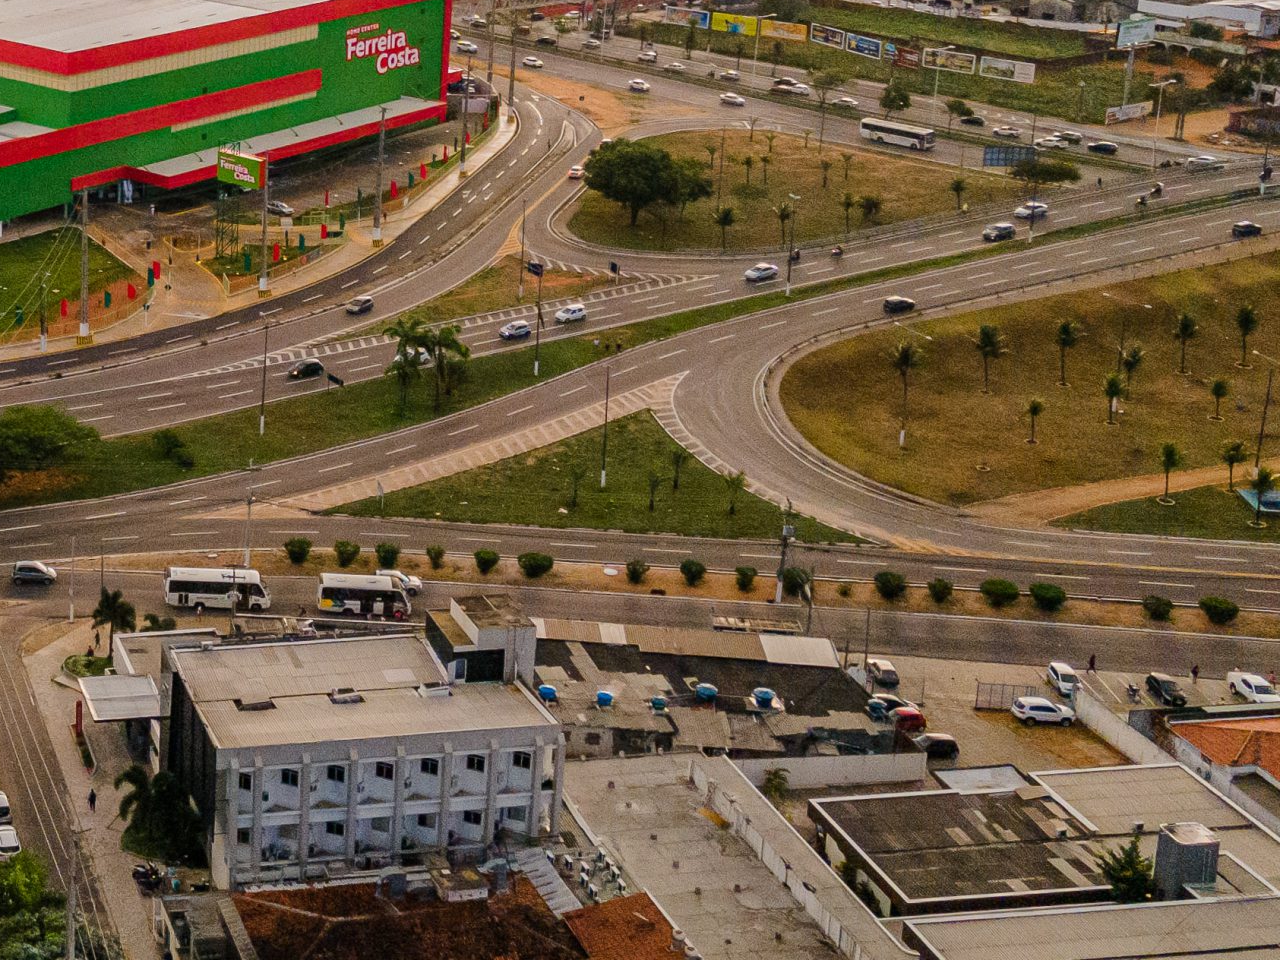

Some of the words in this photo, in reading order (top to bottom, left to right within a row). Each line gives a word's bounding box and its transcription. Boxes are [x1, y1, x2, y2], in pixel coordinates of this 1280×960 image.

[346, 27, 407, 60] Ferreira
[376, 46, 420, 74] Costa
[220, 159, 249, 174] Ferreira
[233, 171, 256, 184] Costa
